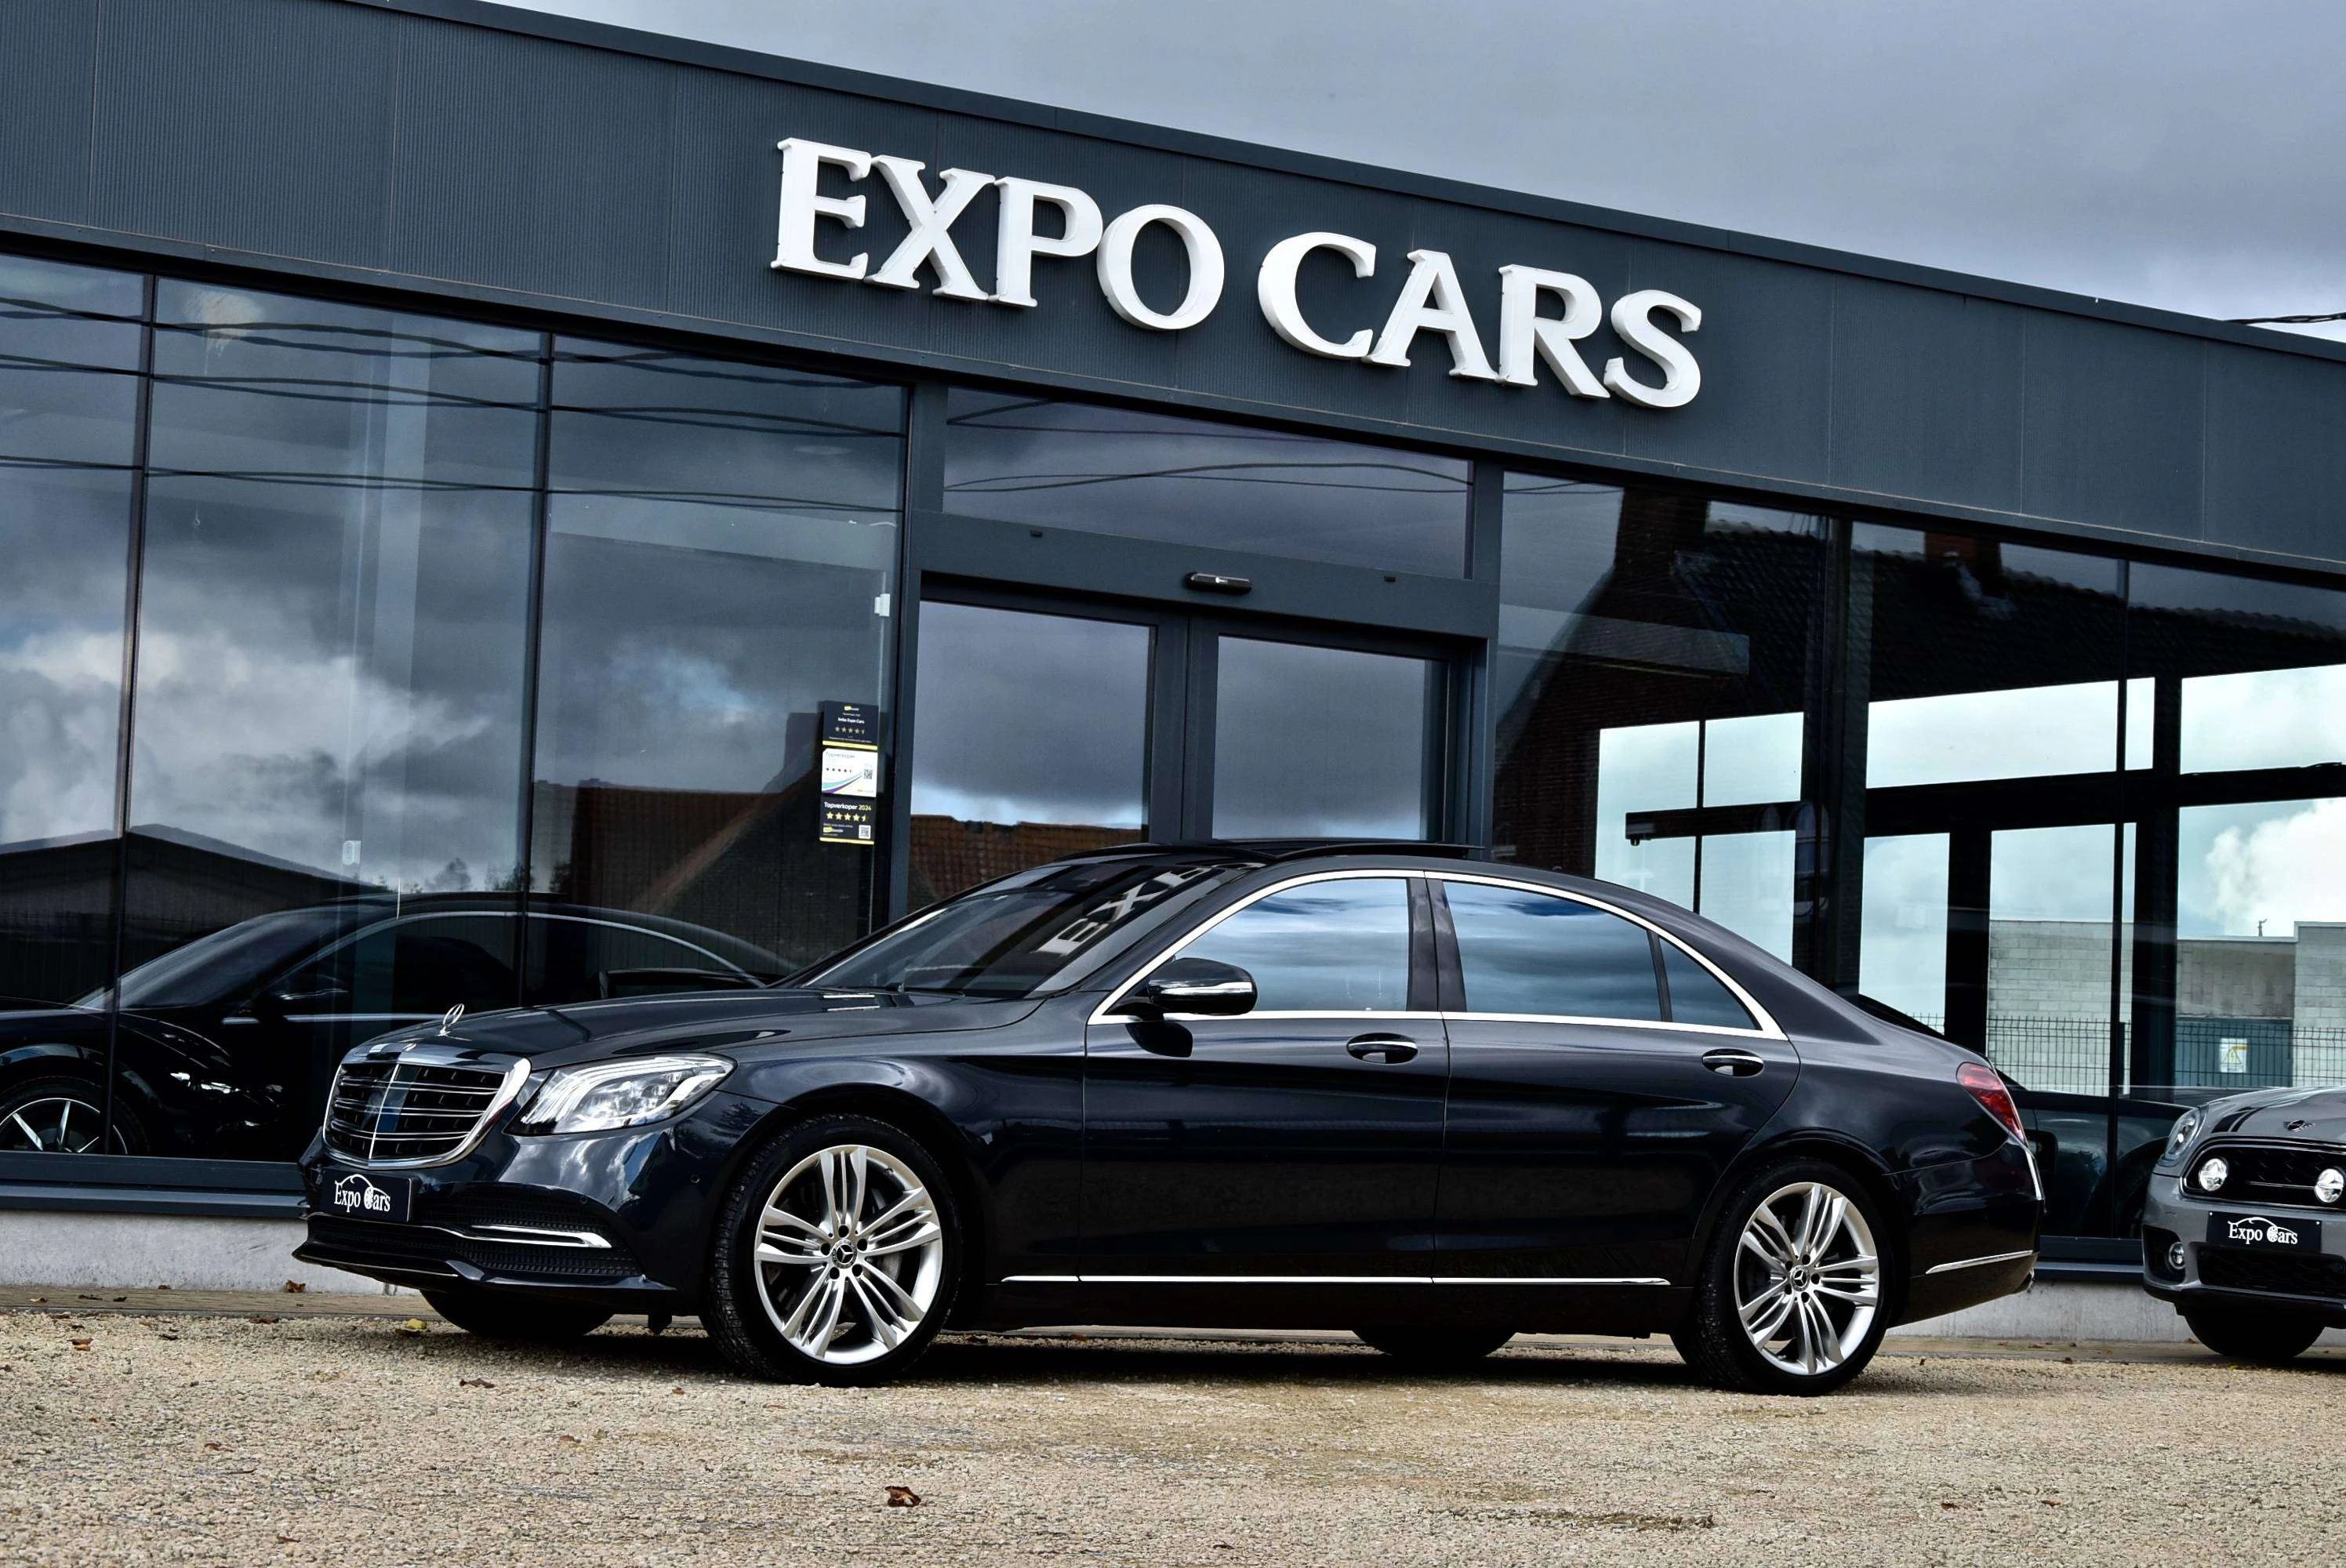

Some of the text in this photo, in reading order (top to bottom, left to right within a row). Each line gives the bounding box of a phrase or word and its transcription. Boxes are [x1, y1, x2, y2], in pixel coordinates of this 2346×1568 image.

[771, 137, 1702, 411] EXPO CARS
[824, 801, 858, 811] Topverkoper
[334, 1180, 390, 1213] Expo Cars
[2228, 1221, 2298, 1245] Expo Cars
